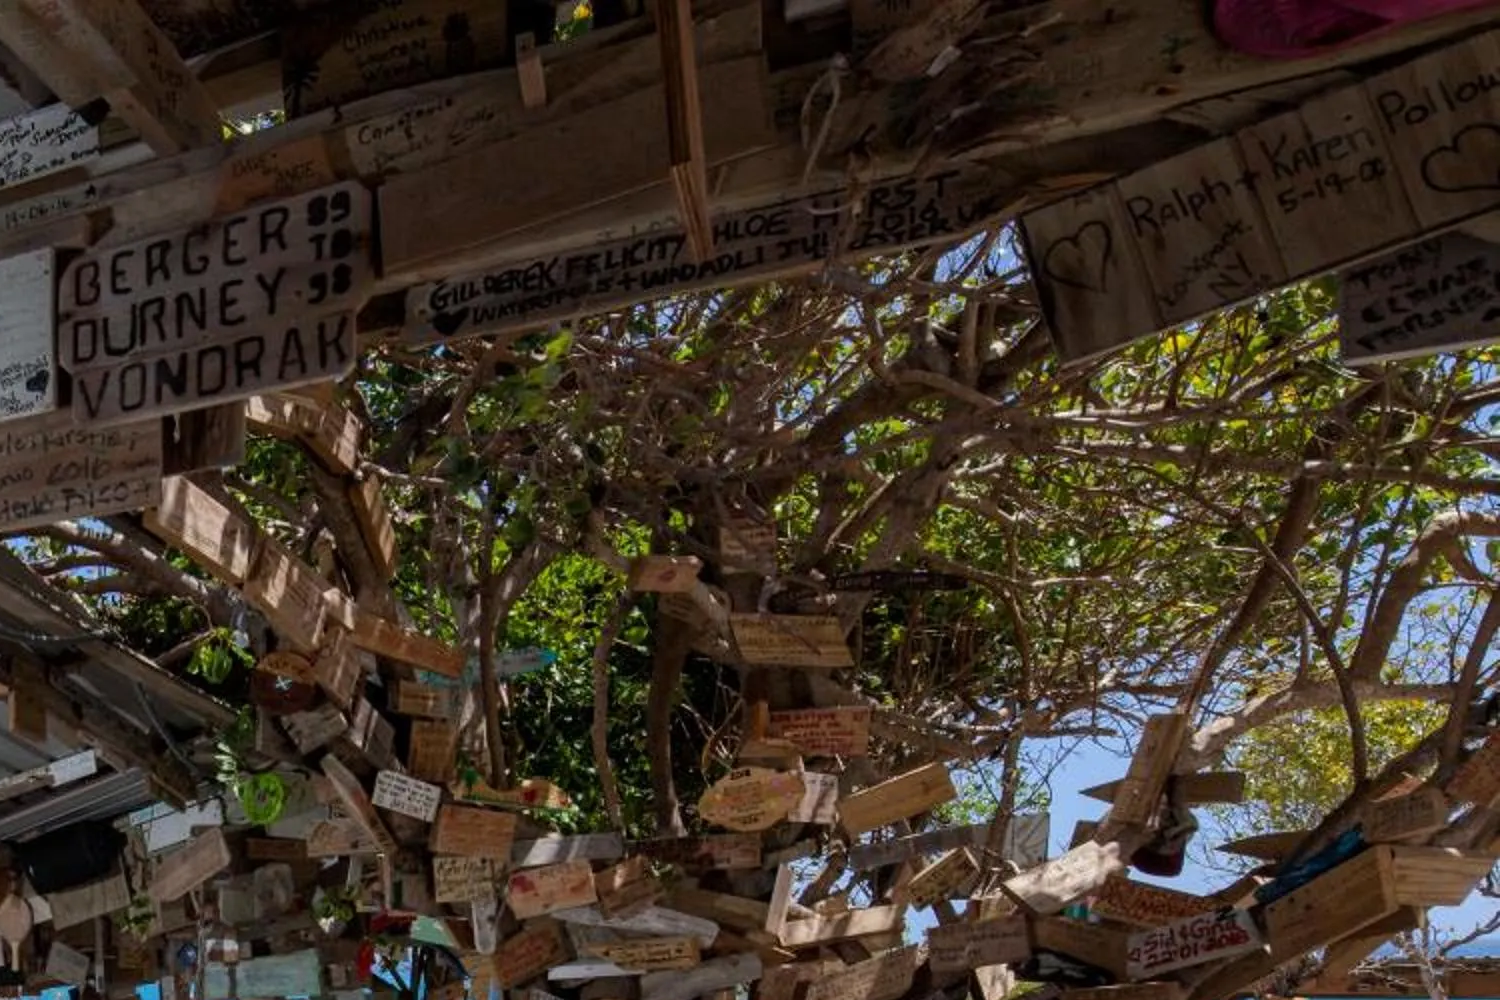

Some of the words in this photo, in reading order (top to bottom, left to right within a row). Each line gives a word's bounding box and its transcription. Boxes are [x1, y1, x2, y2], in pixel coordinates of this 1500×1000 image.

[713, 207, 793, 247] HLOE
[811, 170, 960, 231] HRST
[1126, 176, 1231, 238] Ralph
[1259, 126, 1377, 184] Karen
[75, 205, 290, 308] BERGER
[73, 266, 286, 366] DURNEY
[77, 314, 350, 420] VONDRAK
